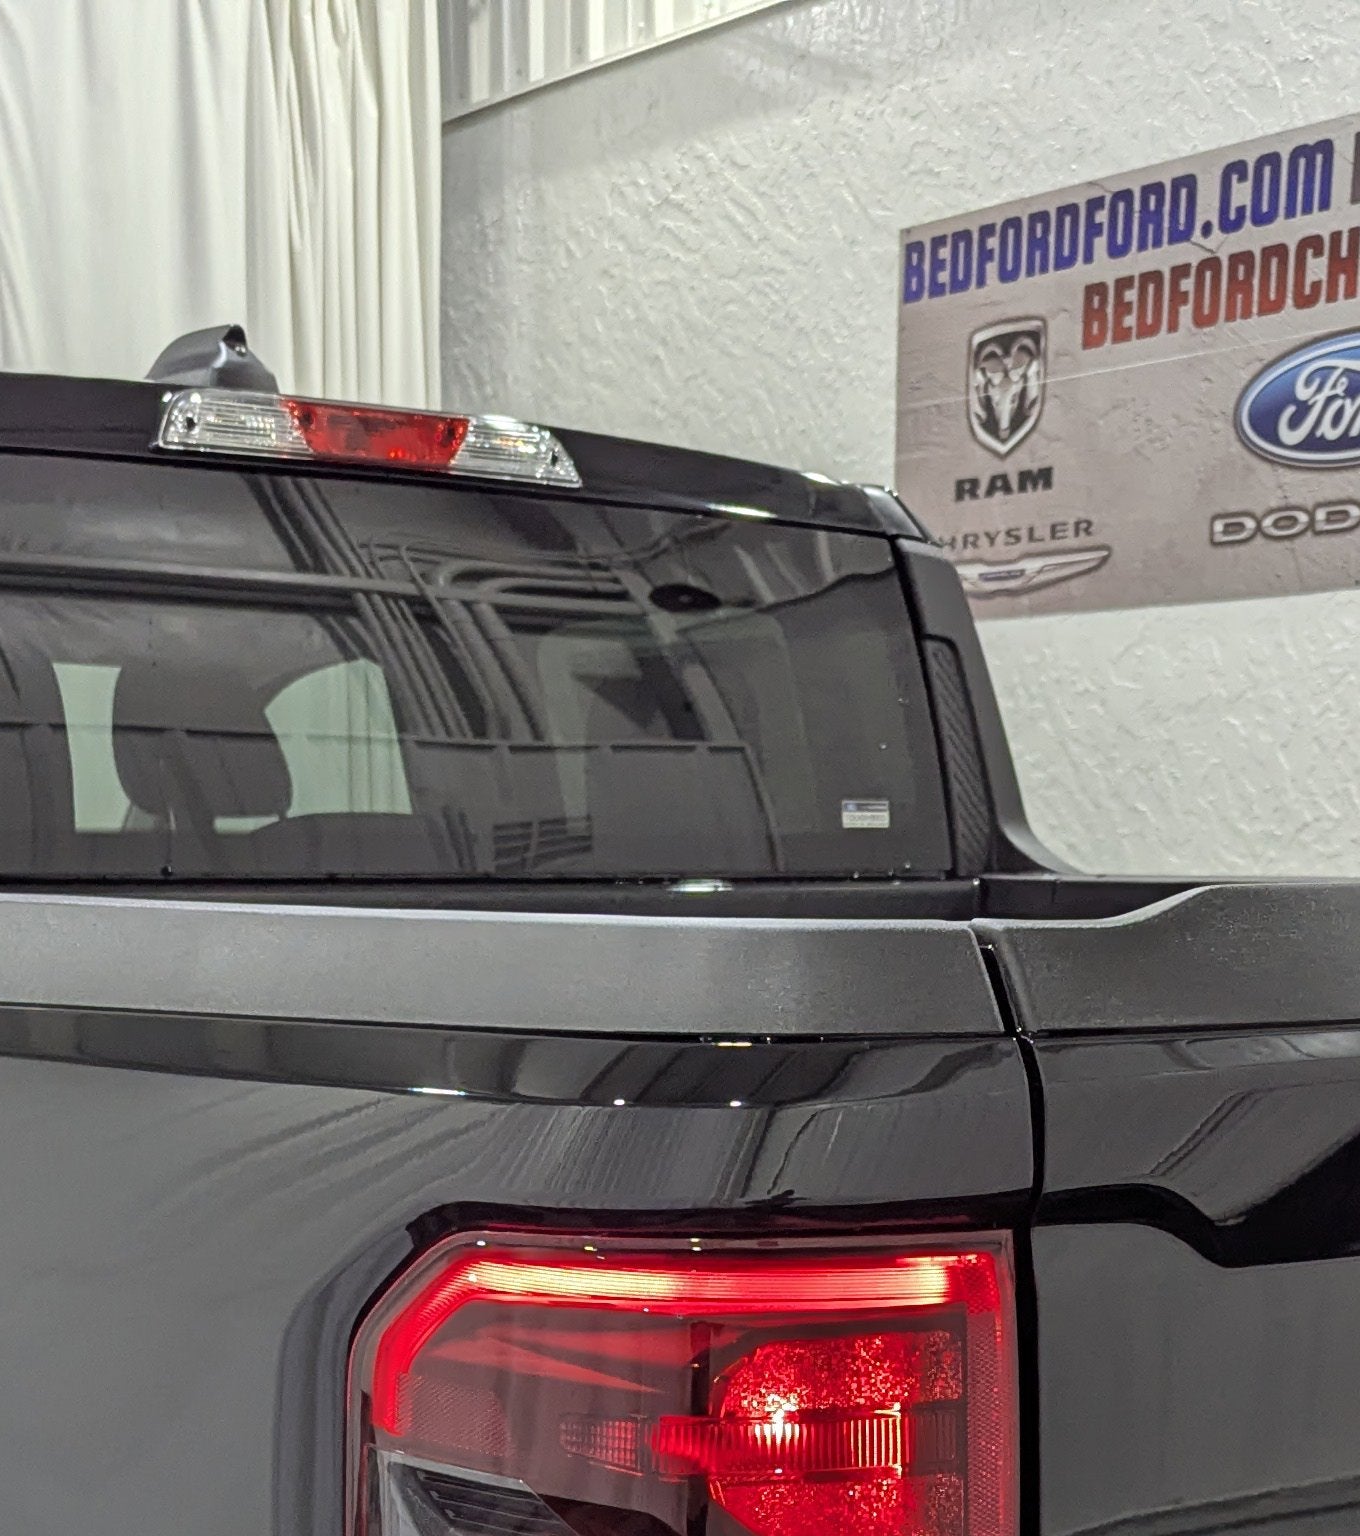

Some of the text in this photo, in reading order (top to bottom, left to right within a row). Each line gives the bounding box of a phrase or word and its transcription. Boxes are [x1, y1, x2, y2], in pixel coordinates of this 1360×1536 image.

[903, 138, 1334, 304] BEDFORDFORD.COM
[954, 466, 1054, 503] RAM
[938, 518, 1094, 550] HRYSLER
